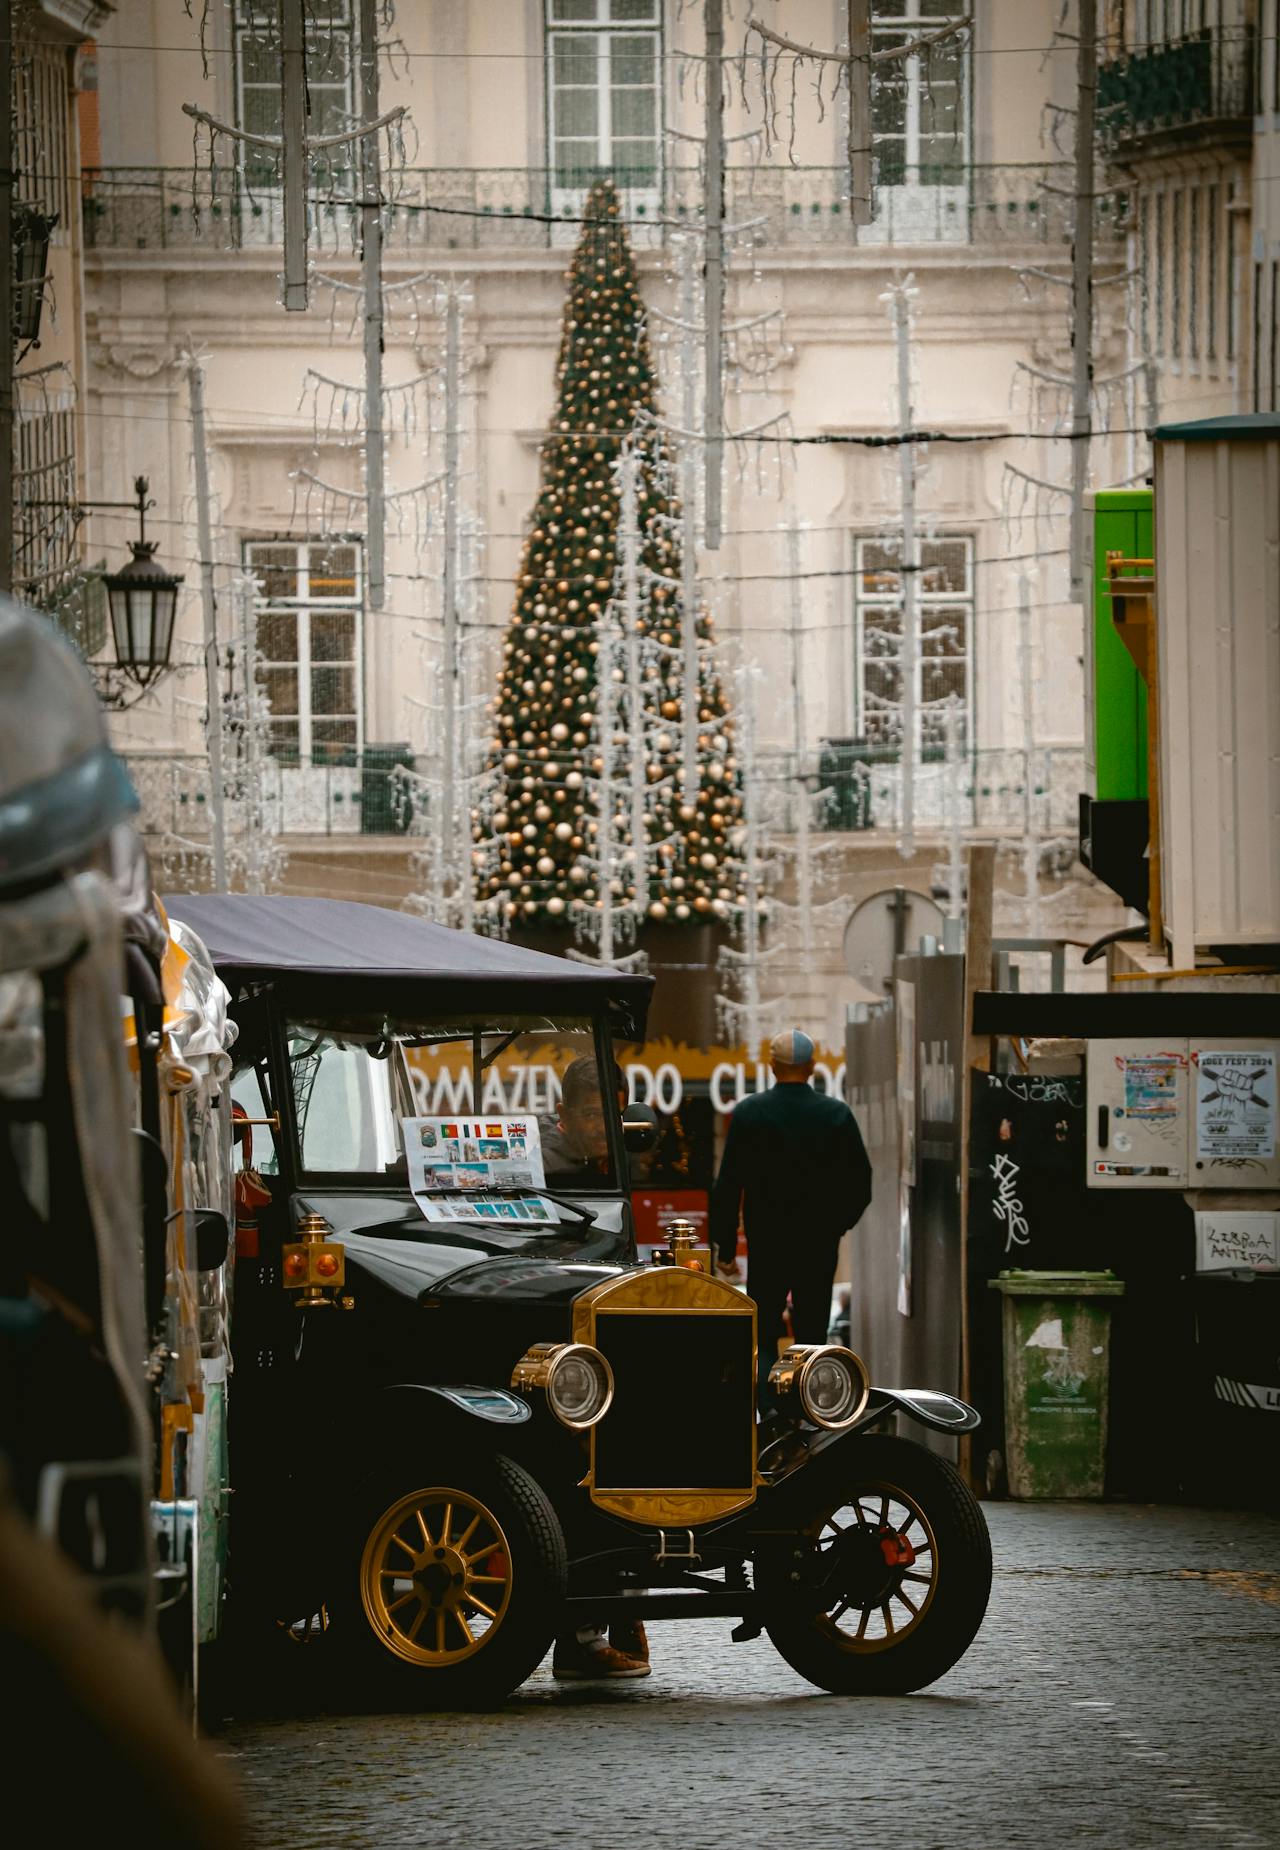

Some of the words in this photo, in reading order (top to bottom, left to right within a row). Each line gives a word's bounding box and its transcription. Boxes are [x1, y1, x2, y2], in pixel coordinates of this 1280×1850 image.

[1226, 1057, 1248, 1066] FEST
[406, 1064, 562, 1115] RMAZEN
[626, 1063, 683, 1115] DO
[1211, 1245, 1277, 1264] ANTIFA
